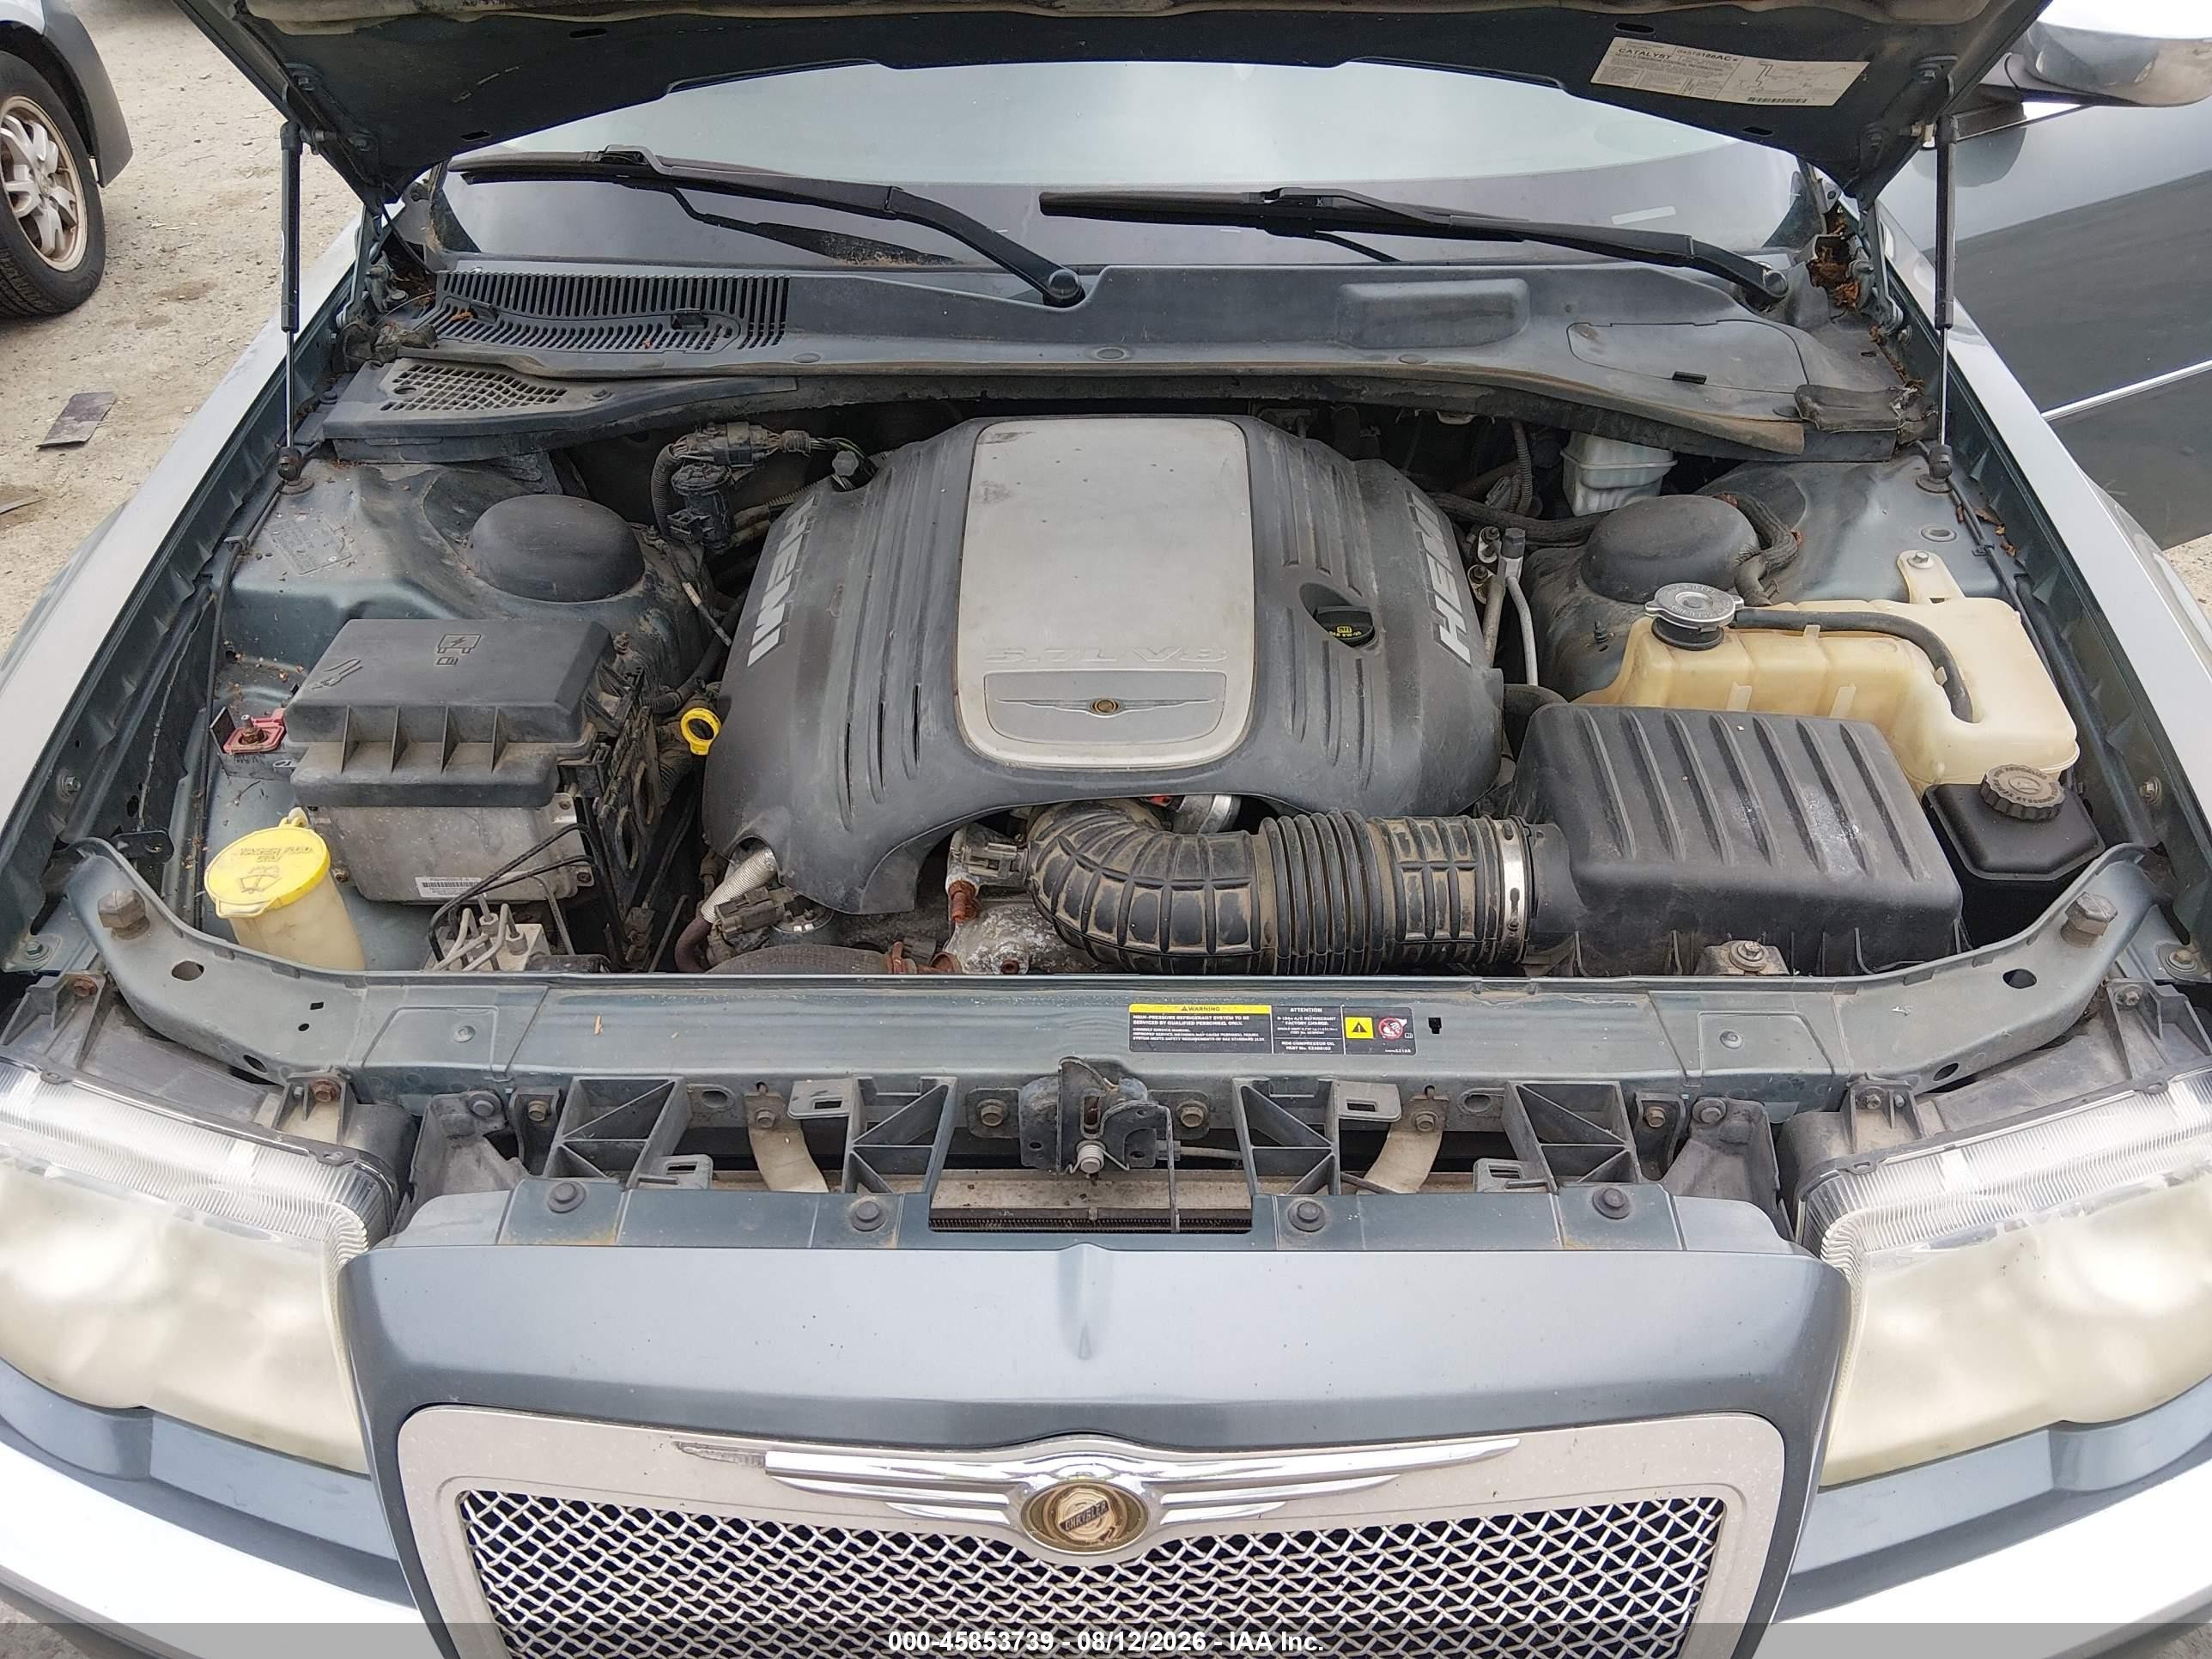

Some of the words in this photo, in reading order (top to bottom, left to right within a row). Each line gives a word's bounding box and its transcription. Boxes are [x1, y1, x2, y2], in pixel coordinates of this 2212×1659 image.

[1618, 47, 1673, 60] CATALYST
[747, 494, 816, 667] HEMI
[1411, 492, 1471, 665] HEMI
[983, 646, 1116, 663] 5.7L
[1132, 646, 1228, 662] V8
[1065, 1500, 1108, 1531] CHRYSLER
